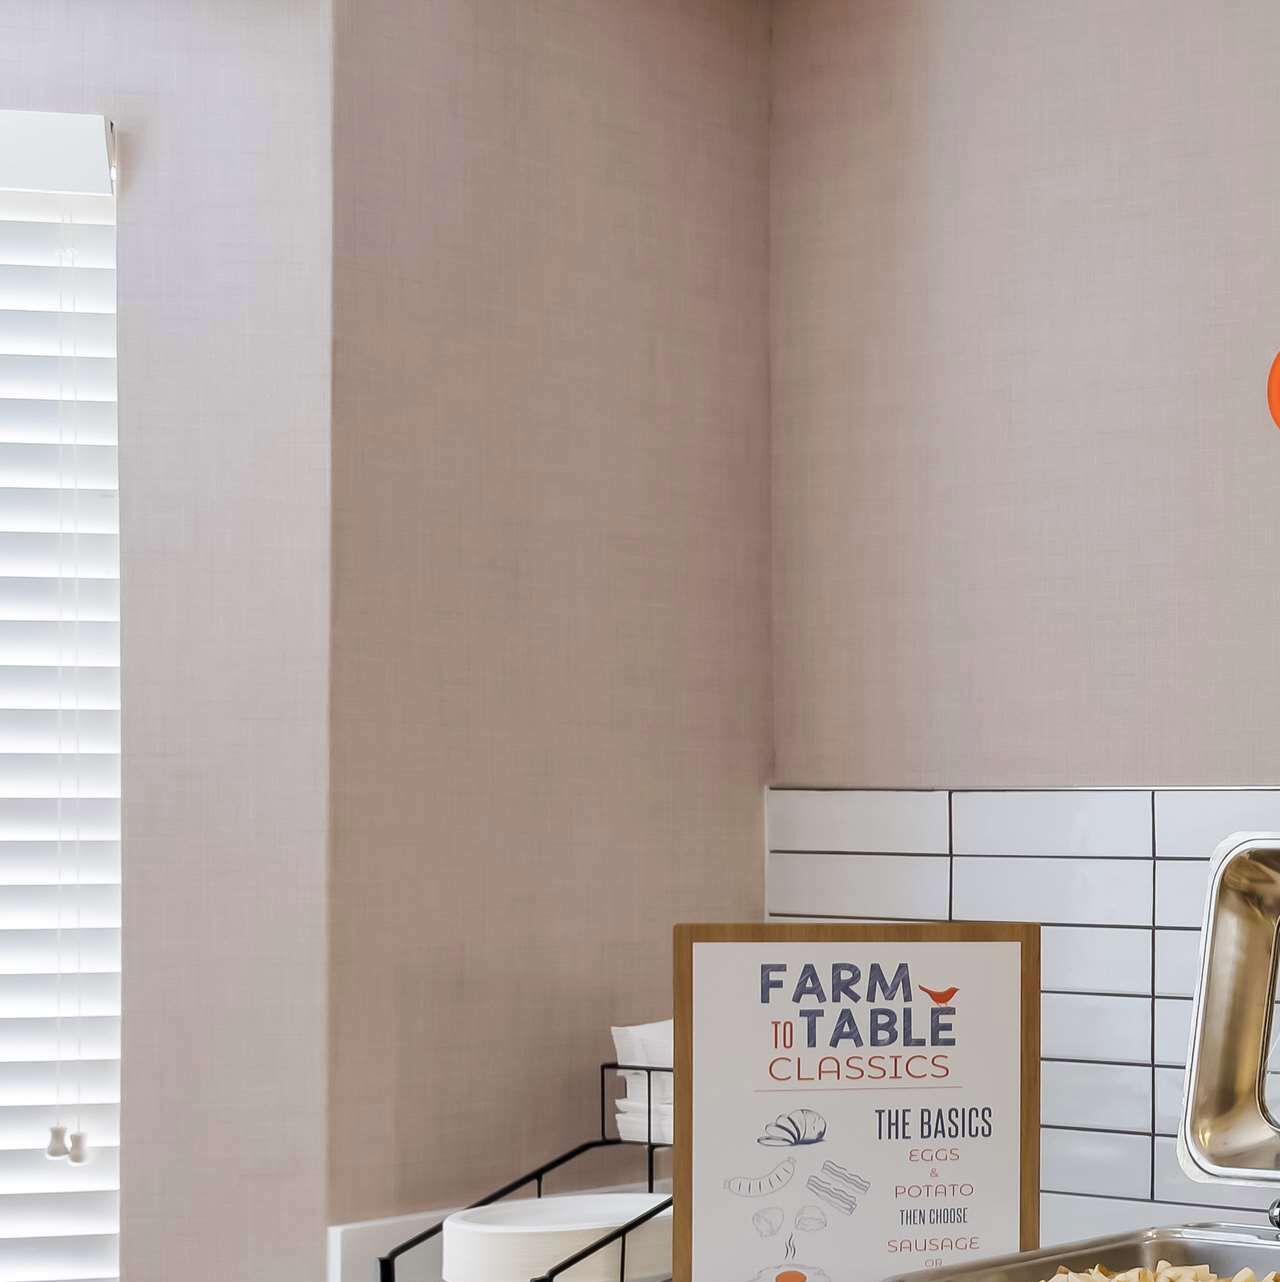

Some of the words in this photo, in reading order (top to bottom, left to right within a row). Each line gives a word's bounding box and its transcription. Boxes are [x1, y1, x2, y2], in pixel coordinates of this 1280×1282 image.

[760, 963, 913, 1004] FARM
[771, 1020, 793, 1049] TO
[799, 1006, 957, 1049] TABLE
[768, 1054, 951, 1081] CLASSICS
[875, 1108, 911, 1141] THE
[920, 1106, 993, 1140] BASICS
[909, 1147, 960, 1162] EGGS
[929, 1167, 939, 1178] &
[895, 1183, 974, 1199] POTATO
[900, 1208, 926, 1226] THEN
[929, 1207, 968, 1225] CHOOSE
[887, 1236, 980, 1253] SAUSAGE
[924, 1258, 943, 1268] OR
